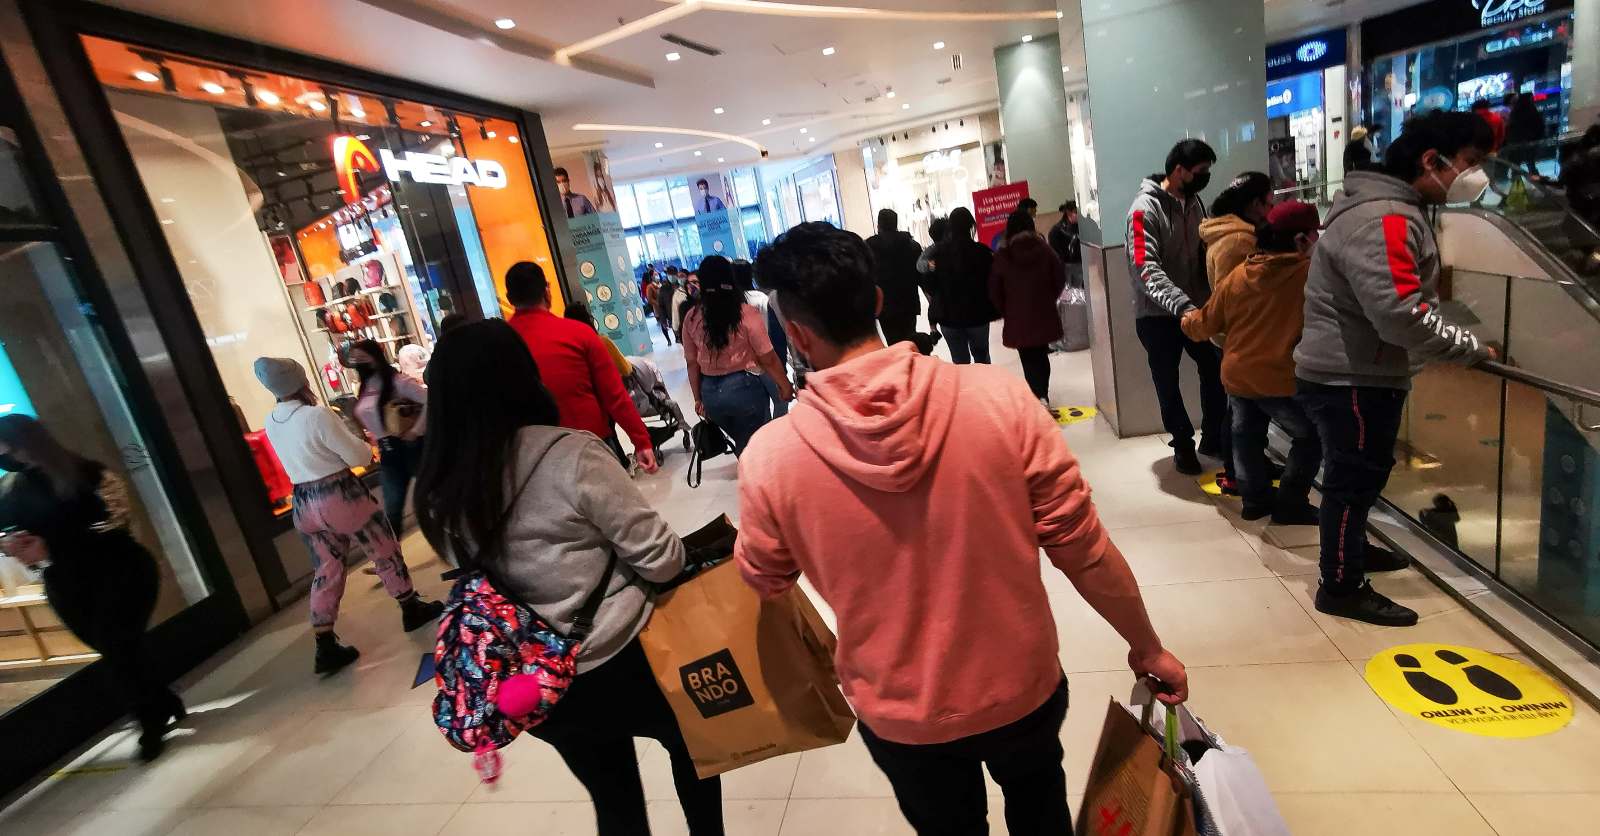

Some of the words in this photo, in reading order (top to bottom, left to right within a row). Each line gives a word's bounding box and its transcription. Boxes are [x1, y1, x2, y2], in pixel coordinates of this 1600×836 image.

[379, 149, 507, 189] HEAD
[688, 662, 732, 690] BRA
[695, 679, 738, 703] NDO
[1421, 708, 1472, 719] METRO
[1501, 701, 1568, 713] MINIMO
